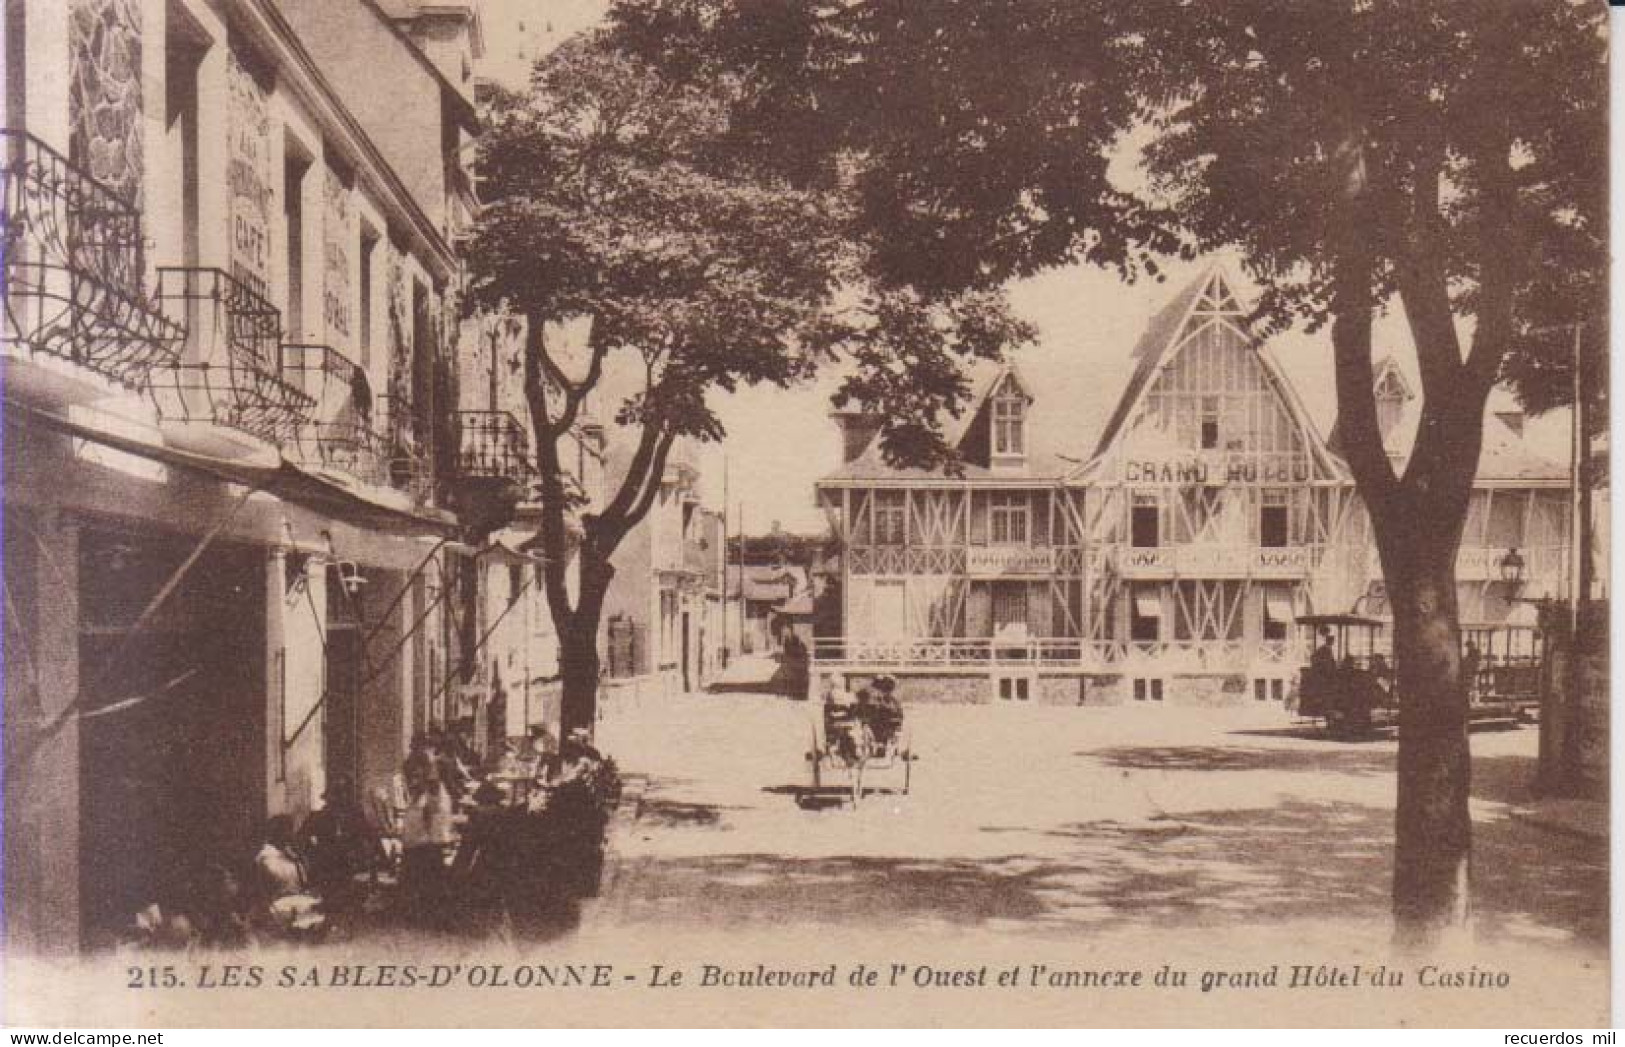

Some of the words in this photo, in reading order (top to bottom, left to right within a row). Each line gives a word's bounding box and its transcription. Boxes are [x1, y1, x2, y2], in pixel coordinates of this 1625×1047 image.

[1126, 460, 1208, 483] GRAND
[127, 966, 185, 988] 215.
[198, 965, 263, 988] LES
[649, 965, 682, 987] Le
[849, 965, 878, 987] de
[998, 966, 1020, 987] et
[1154, 965, 1187, 987] du
[1201, 965, 1278, 993] grand
[1289, 964, 1360, 988] Hôtel
[1370, 965, 1404, 987] du
[1418, 965, 1511, 988] Casino
